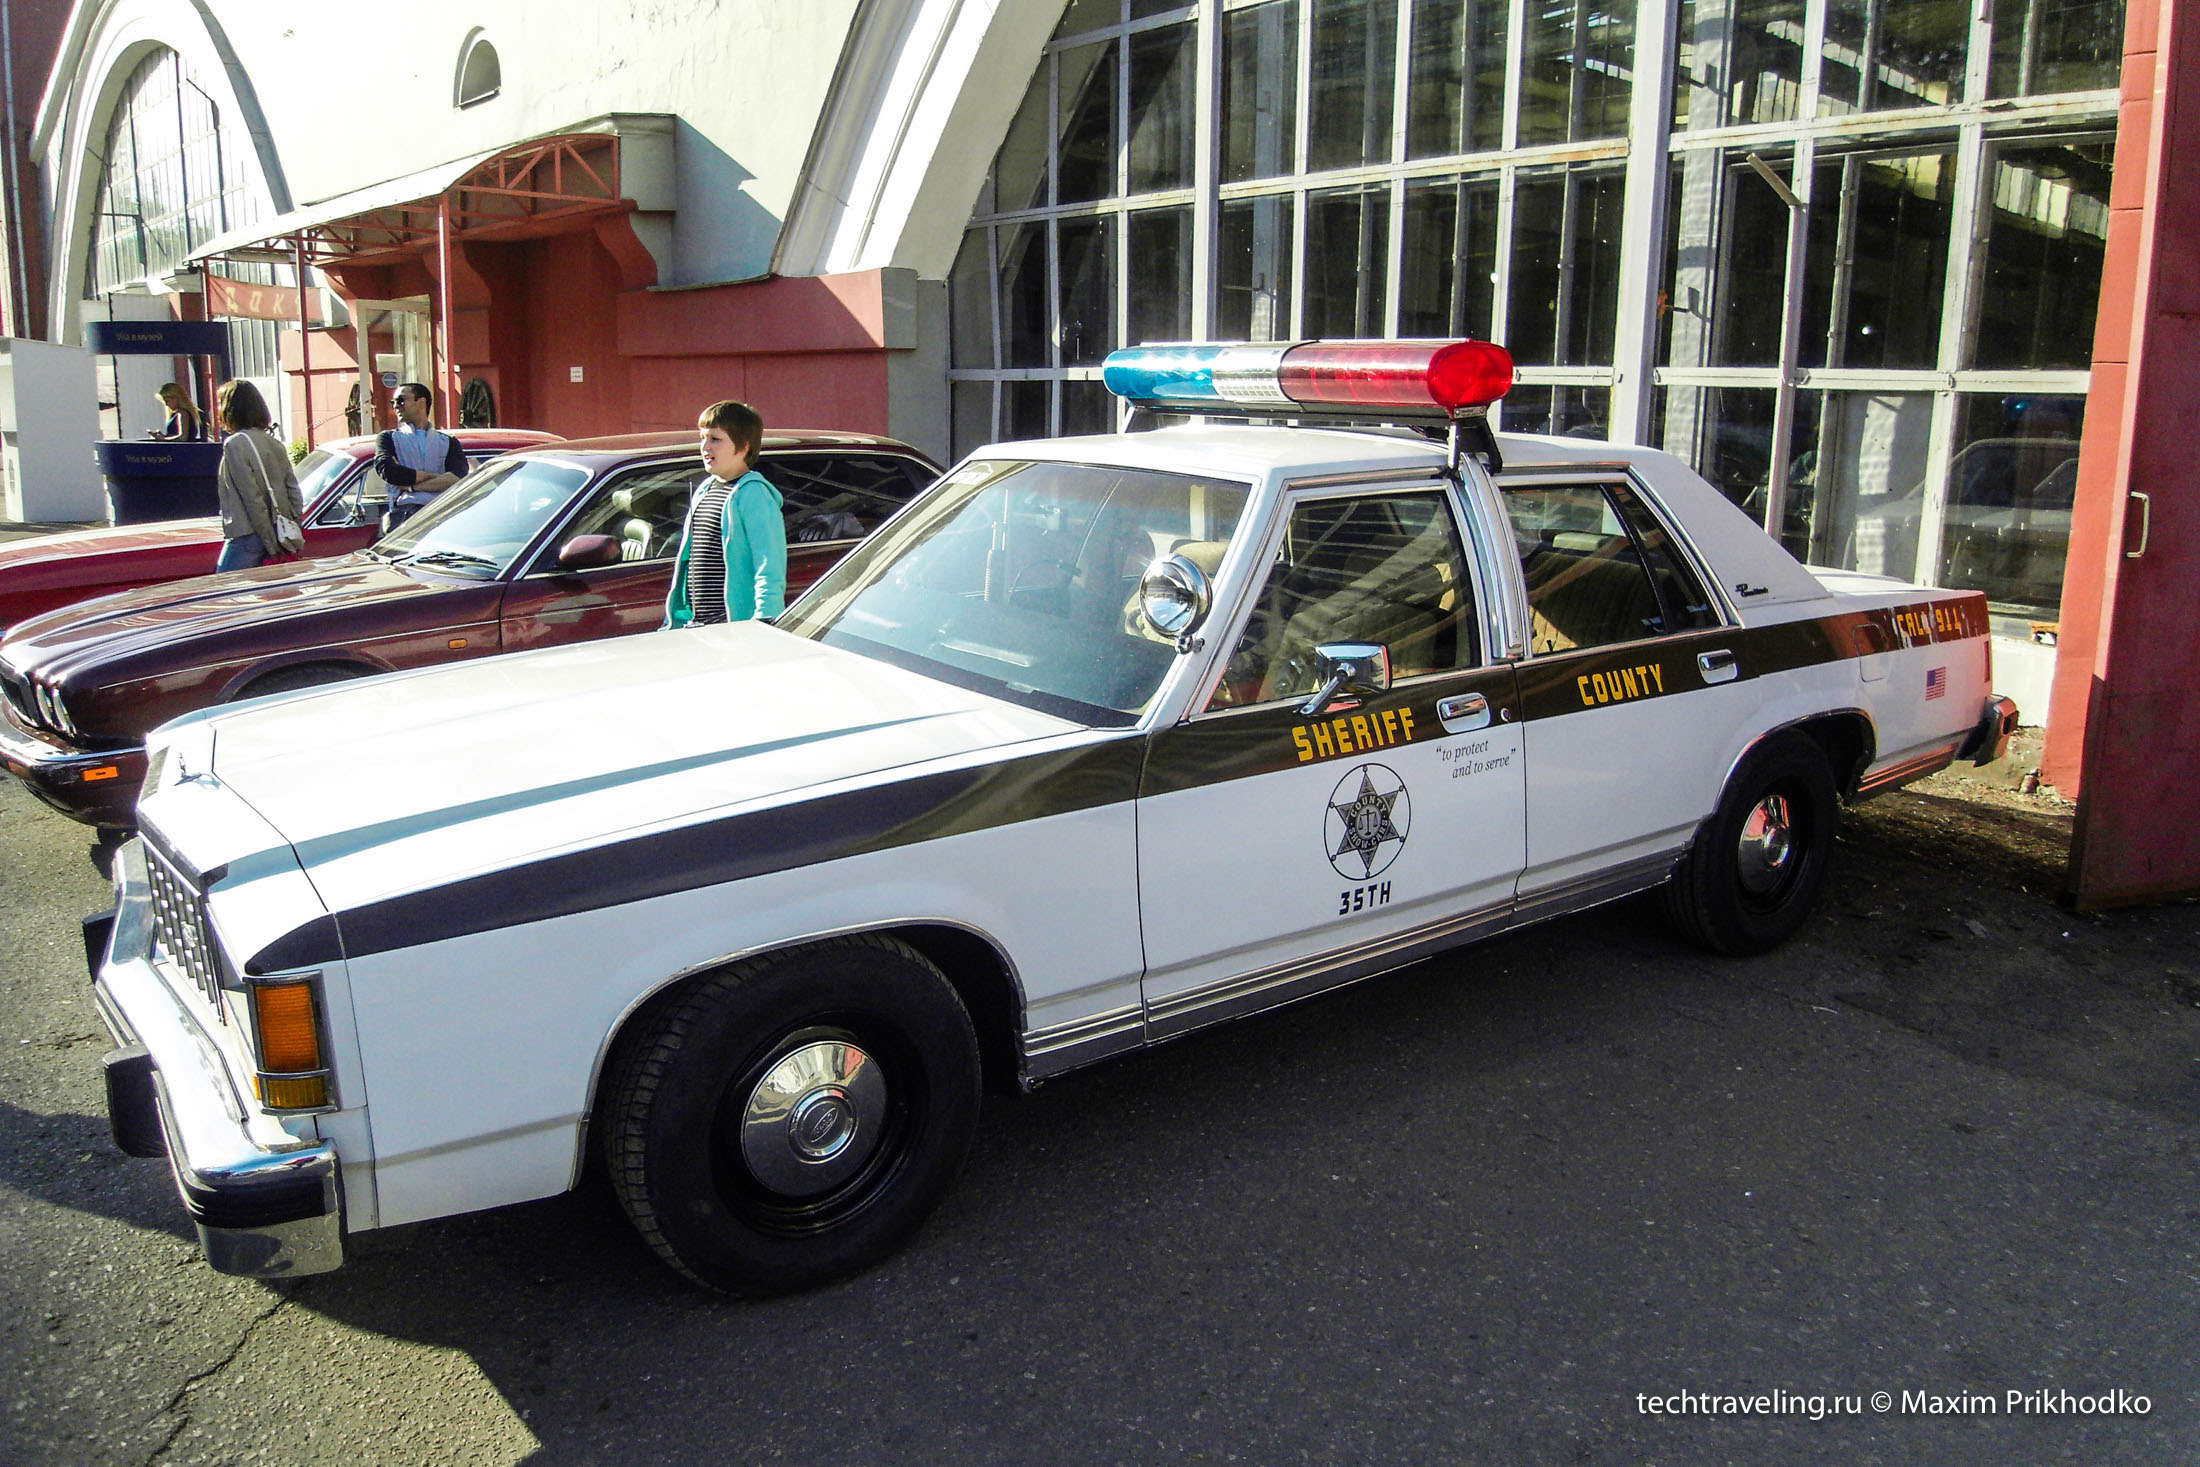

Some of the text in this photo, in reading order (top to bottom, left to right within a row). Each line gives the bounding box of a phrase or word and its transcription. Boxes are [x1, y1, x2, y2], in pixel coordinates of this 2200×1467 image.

[1935, 607, 1960, 632] 911
[1577, 664, 1663, 706] COUNTY
[1292, 707, 1414, 761] SHERIFF
[1454, 740, 1489, 762] protect
[1452, 760, 1472, 779] and
[1473, 762, 1484, 774] to
[1350, 795, 1387, 818] COUNTY
[1339, 880, 1391, 915] 35TH
